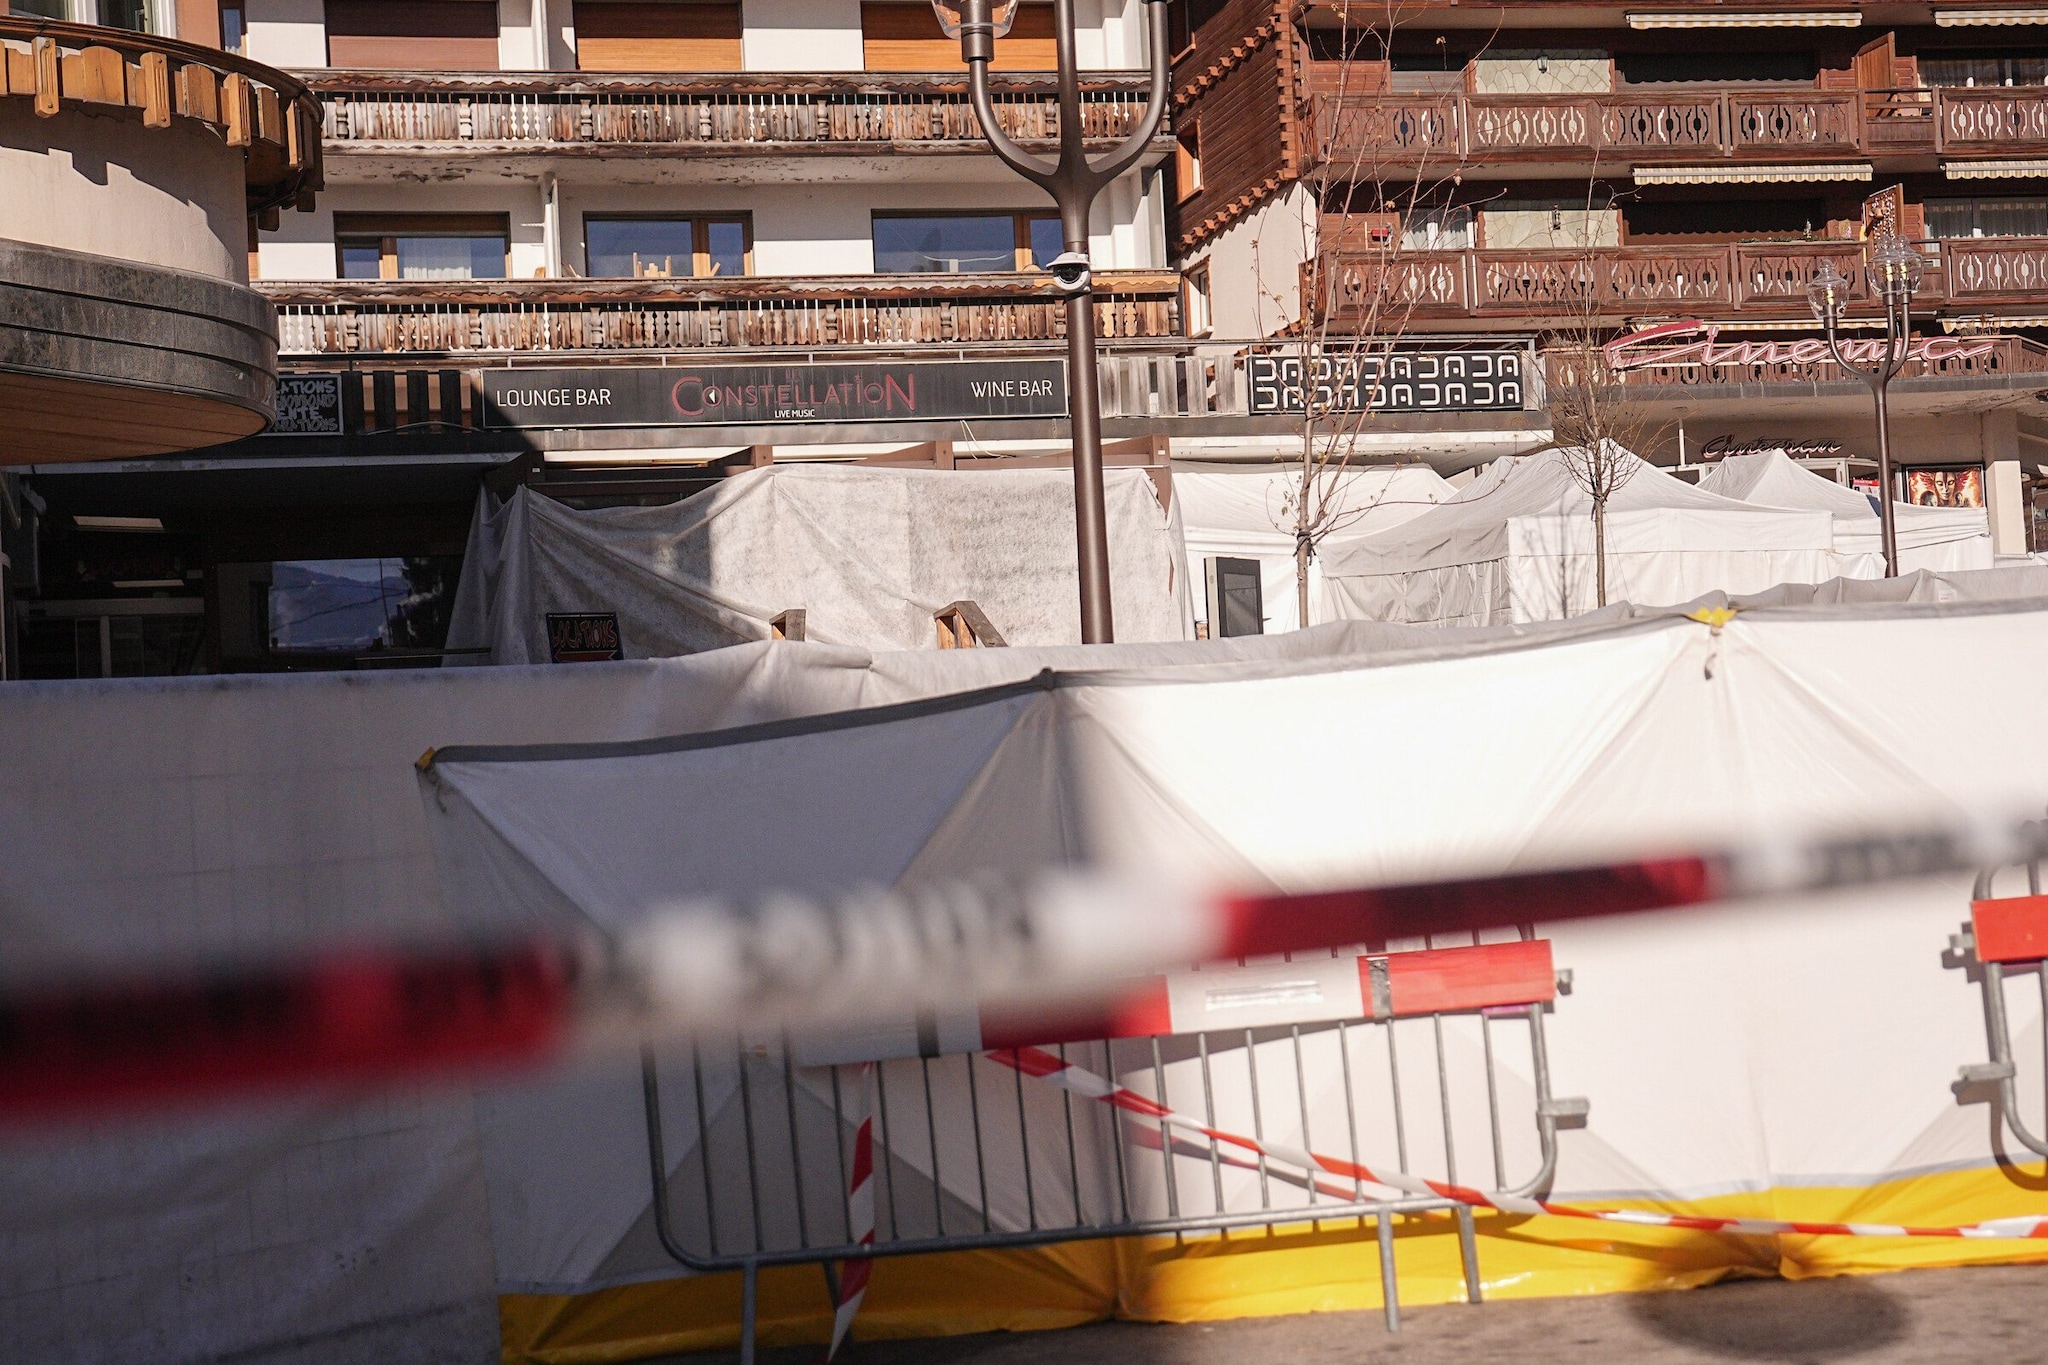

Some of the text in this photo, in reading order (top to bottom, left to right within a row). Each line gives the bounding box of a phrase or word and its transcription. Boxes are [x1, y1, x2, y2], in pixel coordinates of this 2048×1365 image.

[1602, 319, 1993, 371] Cinema
[276, 380, 336, 394] ATIONS
[970, 379, 1053, 398] WINE BAR
[496, 388, 612, 407] LOUNGE BAR
[774, 408, 816, 418] LIVE MUSIC
